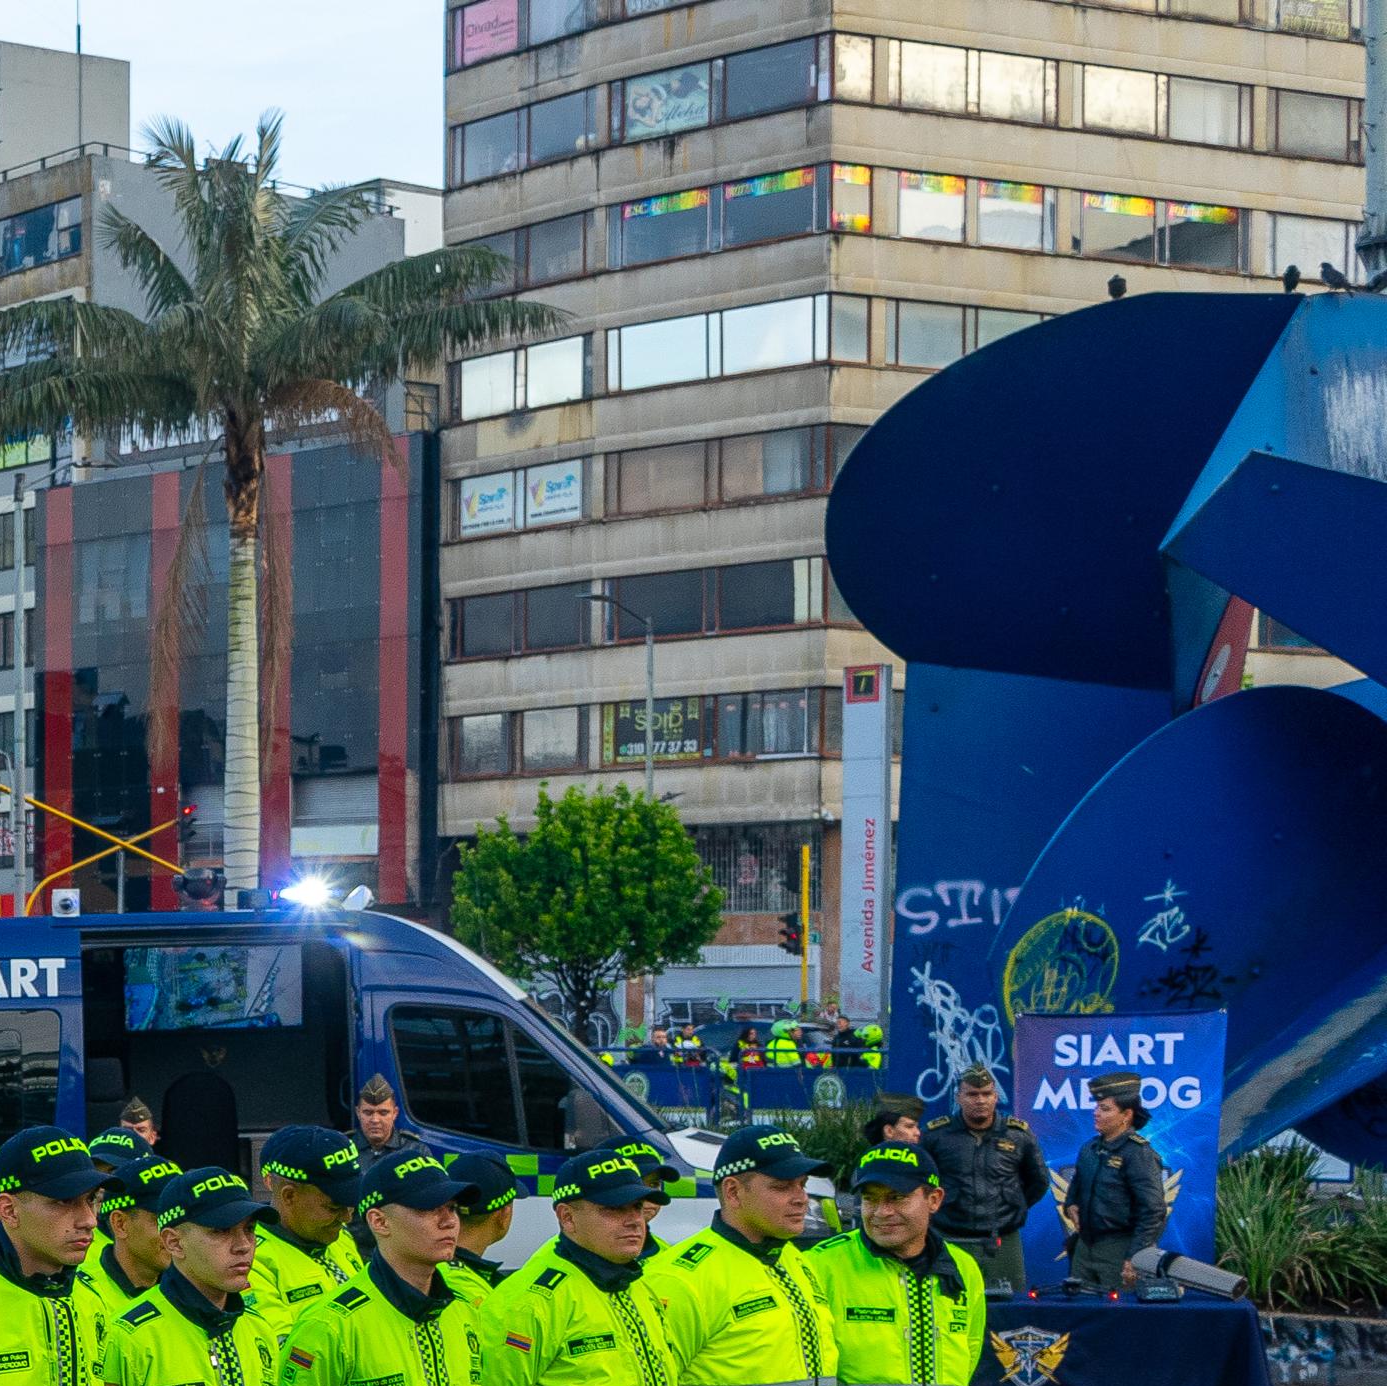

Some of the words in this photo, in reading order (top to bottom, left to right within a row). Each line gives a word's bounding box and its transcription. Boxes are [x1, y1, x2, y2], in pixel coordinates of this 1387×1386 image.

[861, 817, 876, 891] Jiménez
[861, 899, 875, 973] Avenida
[1055, 1033, 1184, 1067] SIART
[860, 1147, 919, 1168] POLICÍA
